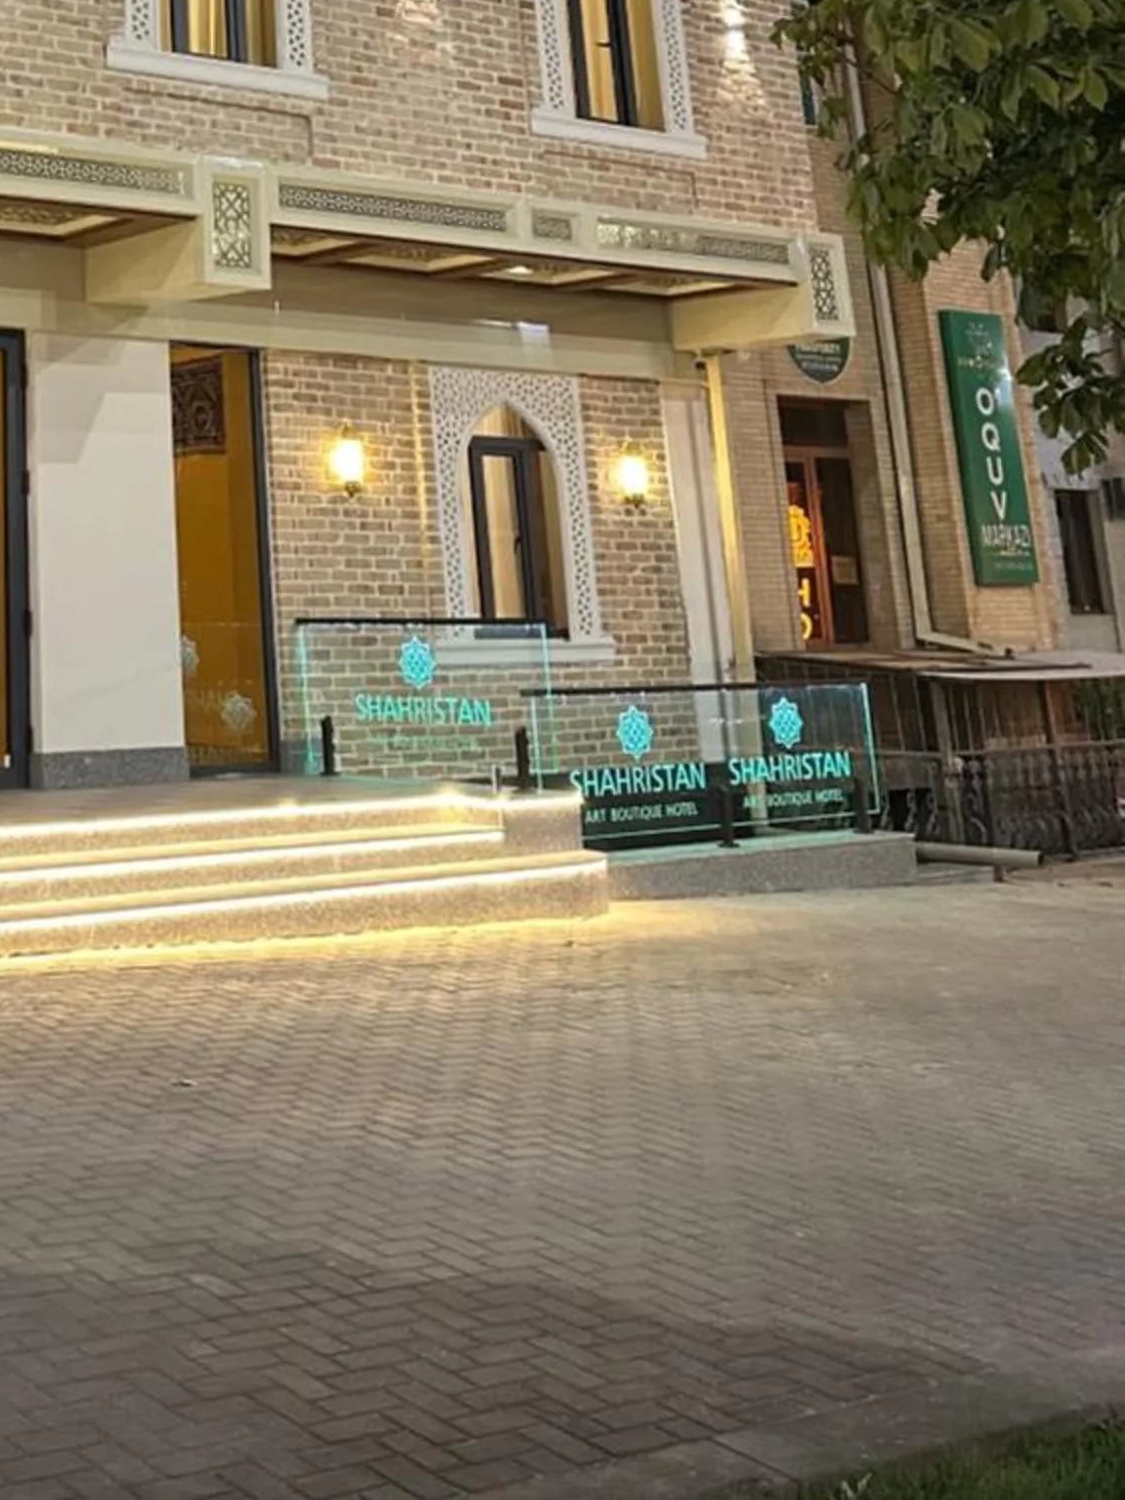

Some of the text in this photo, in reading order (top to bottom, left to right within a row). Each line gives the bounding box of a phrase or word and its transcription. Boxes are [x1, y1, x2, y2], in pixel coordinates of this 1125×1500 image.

[355, 693, 491, 726] SHAHRISTAN
[570, 762, 706, 796] SHAHRISTAN
[728, 752, 851, 785] SHAHRISTAN
[585, 802, 699, 823] ART BOUTIQUE HOTEL
